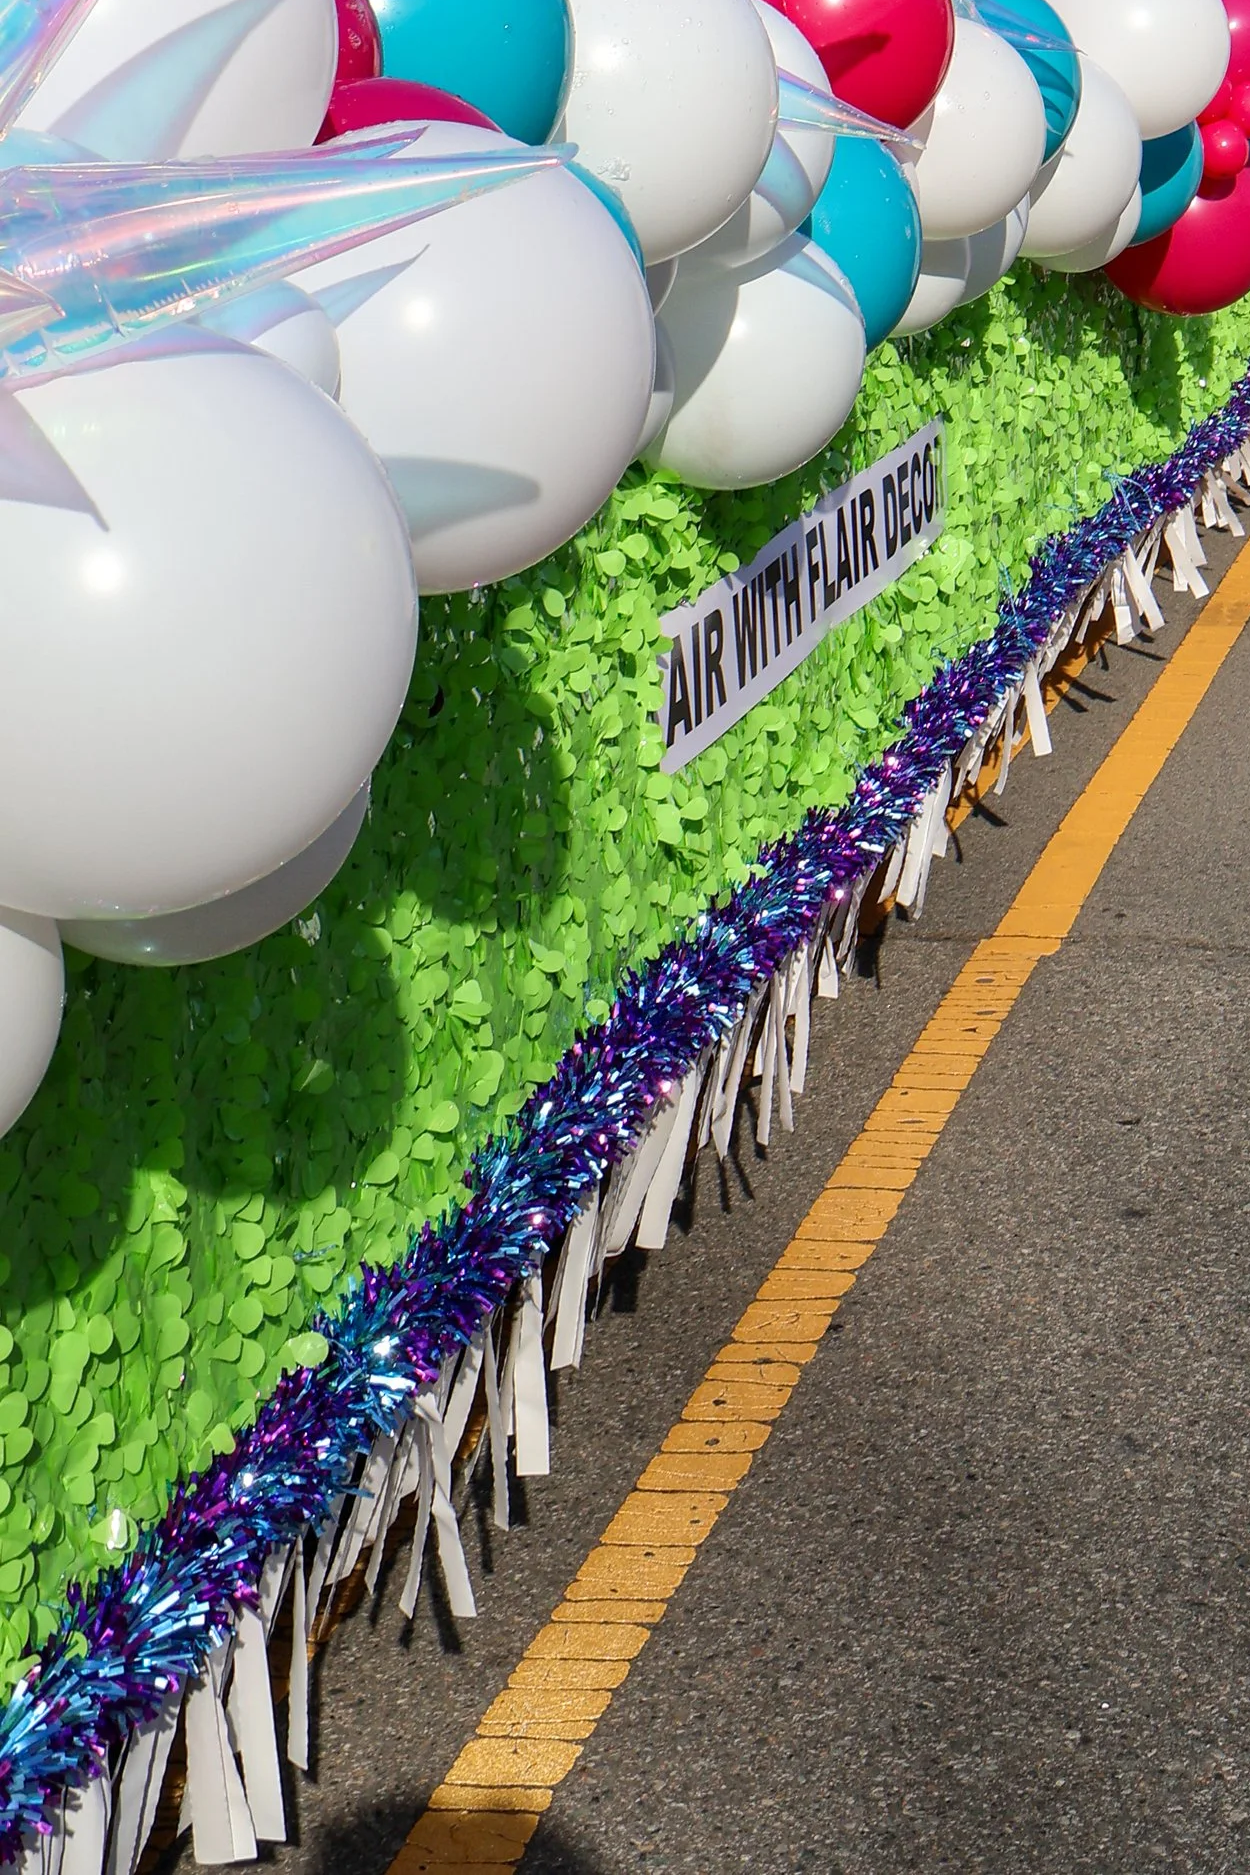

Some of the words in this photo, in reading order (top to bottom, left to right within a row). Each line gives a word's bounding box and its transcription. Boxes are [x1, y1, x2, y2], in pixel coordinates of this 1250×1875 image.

[667, 609, 727, 747] AIR
[732, 542, 803, 690] WITH
[805, 488, 880, 624] FLAIR
